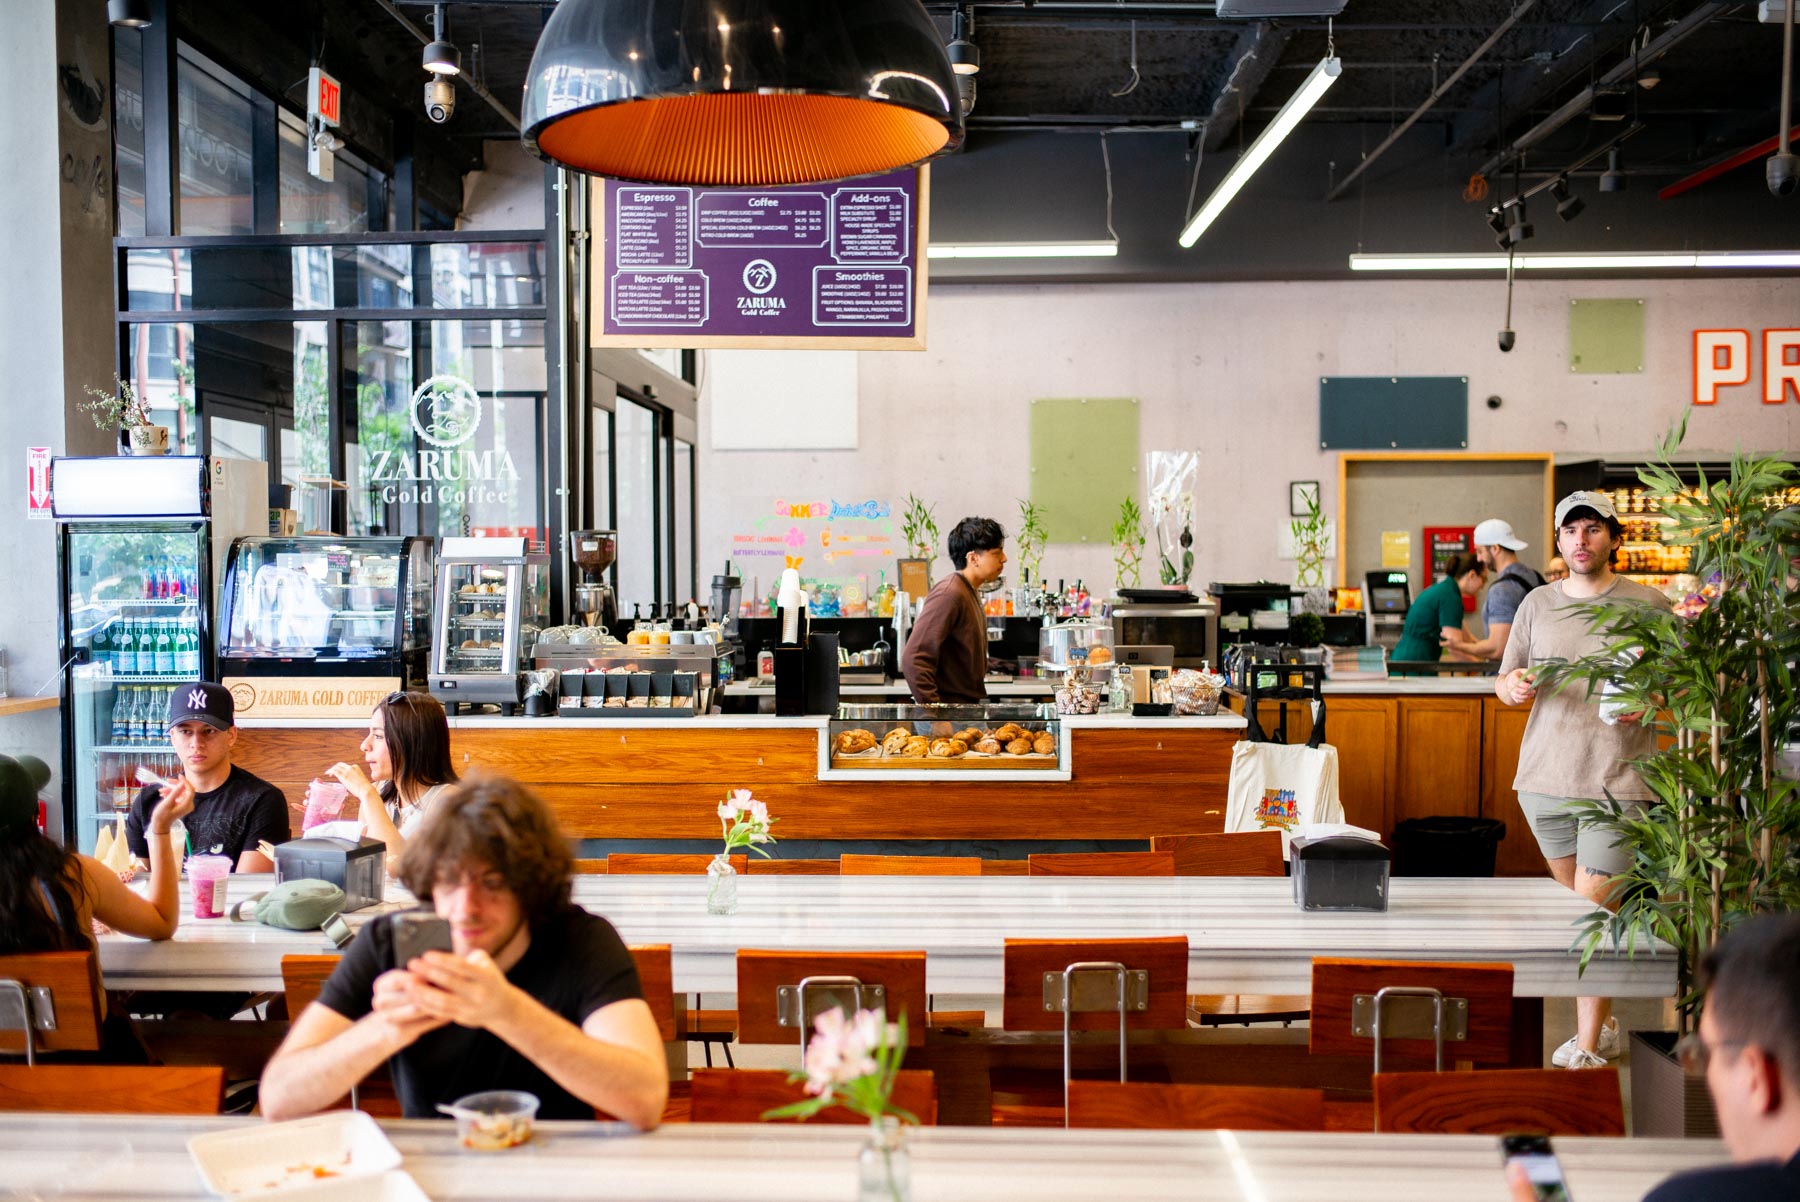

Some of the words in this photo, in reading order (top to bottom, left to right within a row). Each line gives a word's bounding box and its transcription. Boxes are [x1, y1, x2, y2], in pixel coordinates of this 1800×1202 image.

[320, 76, 339, 124] EXIT
[634, 193, 676, 204] Espresso
[748, 197, 780, 207] Coffee
[851, 194, 890, 203] Add-ons
[634, 274, 684, 284] Non-coffee
[835, 272, 885, 281] Smoothies
[736, 297, 787, 309] ZARUMA
[371, 450, 522, 481] ZARUMA
[382, 485, 434, 505] Gold
[437, 485, 508, 505] Coffee
[1388, 573, 1407, 583] ATM
[259, 690, 311, 706] ZARUMA
[311, 690, 345, 706] GOLD
